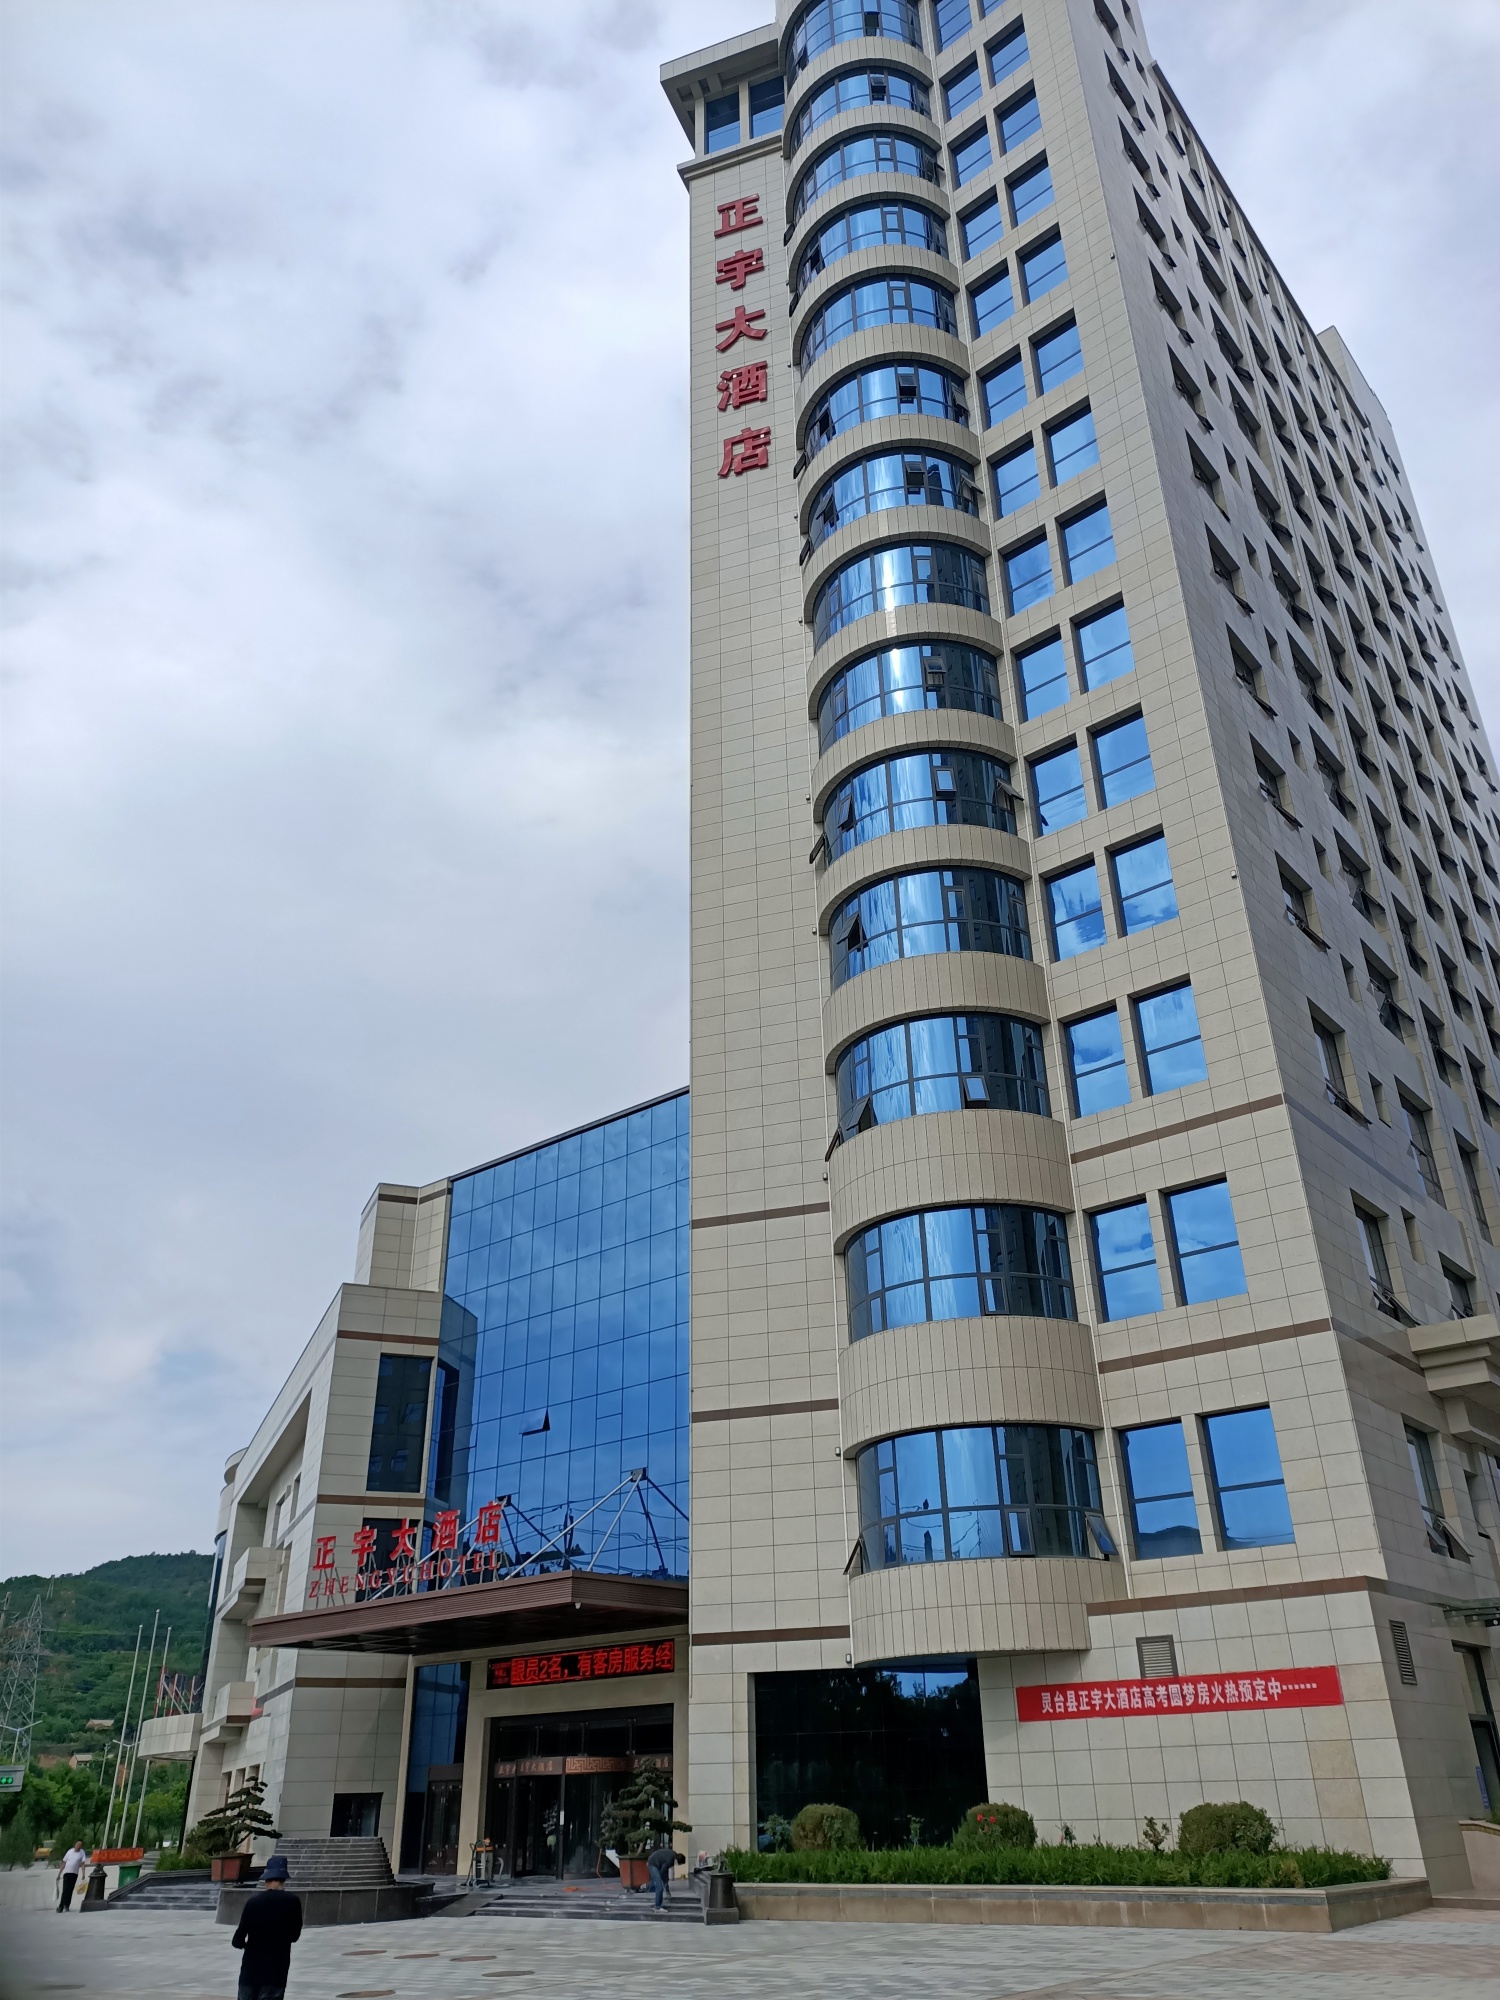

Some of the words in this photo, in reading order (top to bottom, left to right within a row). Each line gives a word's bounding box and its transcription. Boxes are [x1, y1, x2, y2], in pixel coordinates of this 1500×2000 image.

[714, 193, 771, 479] 正宇大酒店
[313, 1500, 503, 1571] 正宇大酒店
